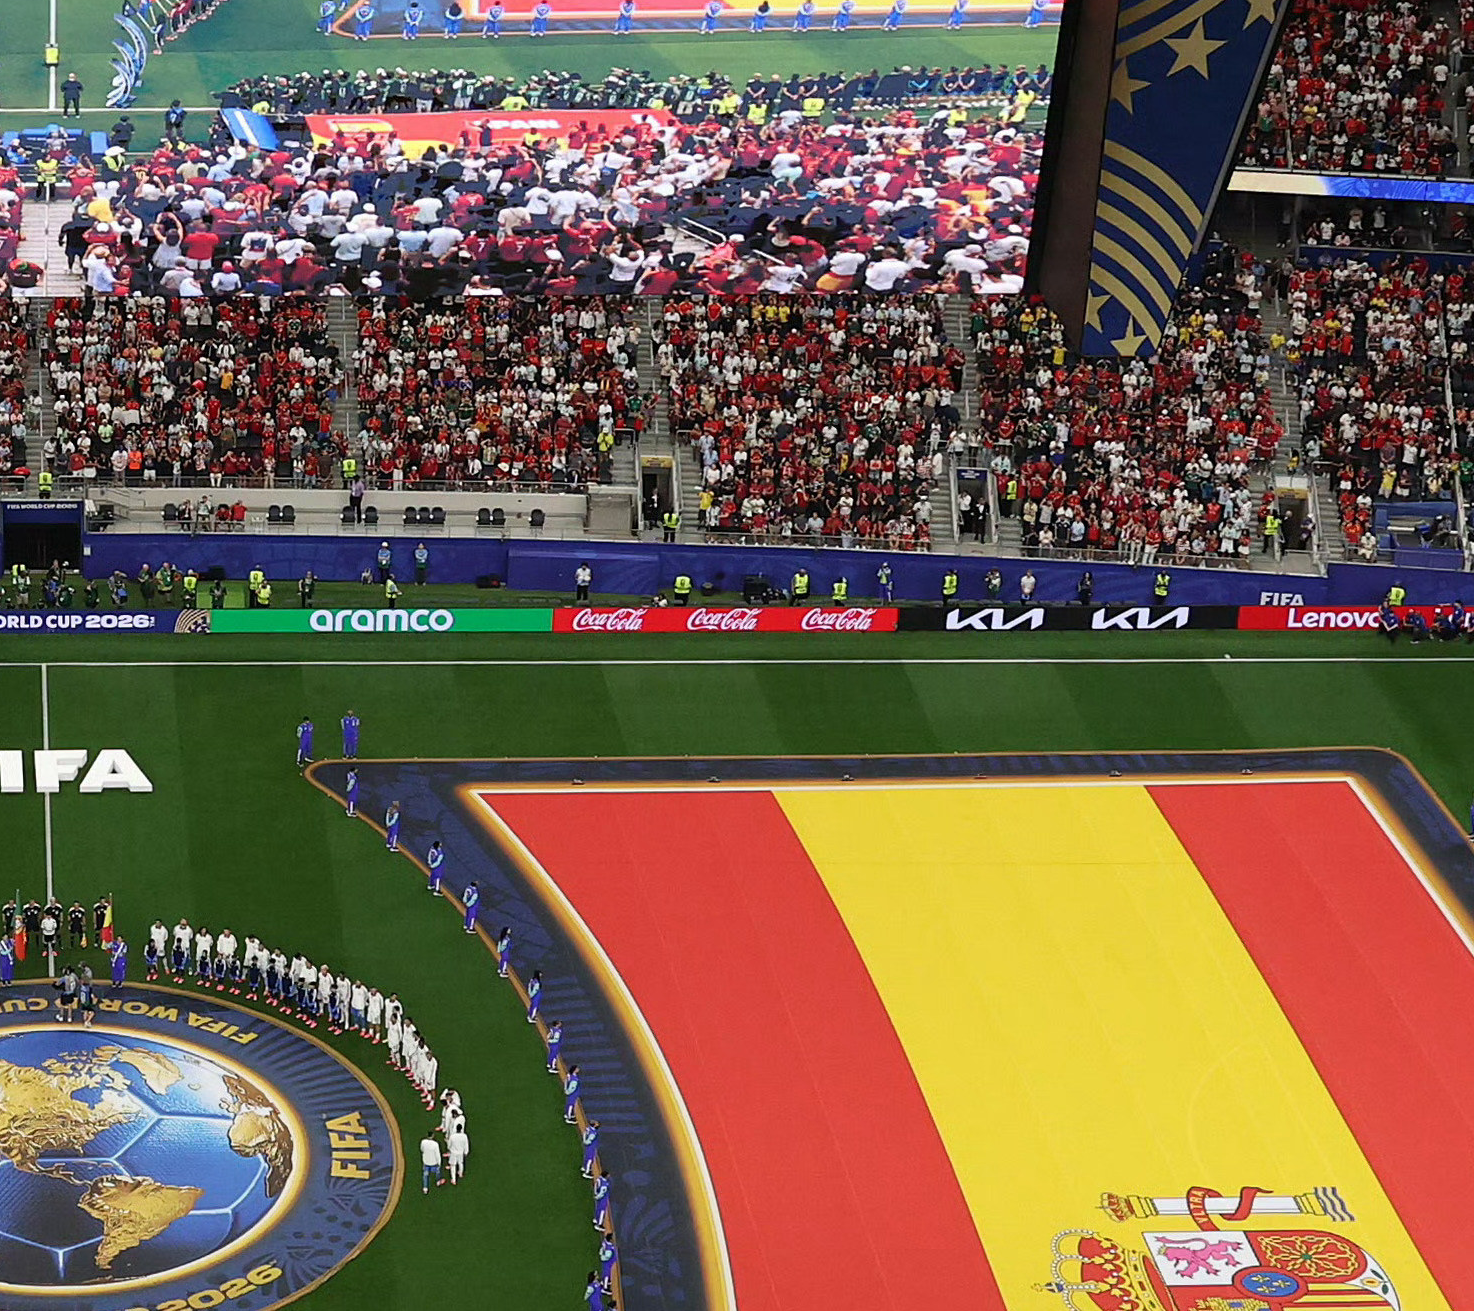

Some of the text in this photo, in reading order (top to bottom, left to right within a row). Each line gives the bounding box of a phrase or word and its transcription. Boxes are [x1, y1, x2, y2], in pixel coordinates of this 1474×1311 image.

[1260, 591, 1305, 606] FIFA
[45, 614, 83, 629] CUP
[309, 608, 455, 632] aramco
[946, 607, 1045, 631] KIA
[1091, 606, 1190, 630] KIA
[62, 997, 178, 1022] WOR
[188, 1012, 258, 1046] FIFA
[325, 1111, 371, 1180] FIFA
